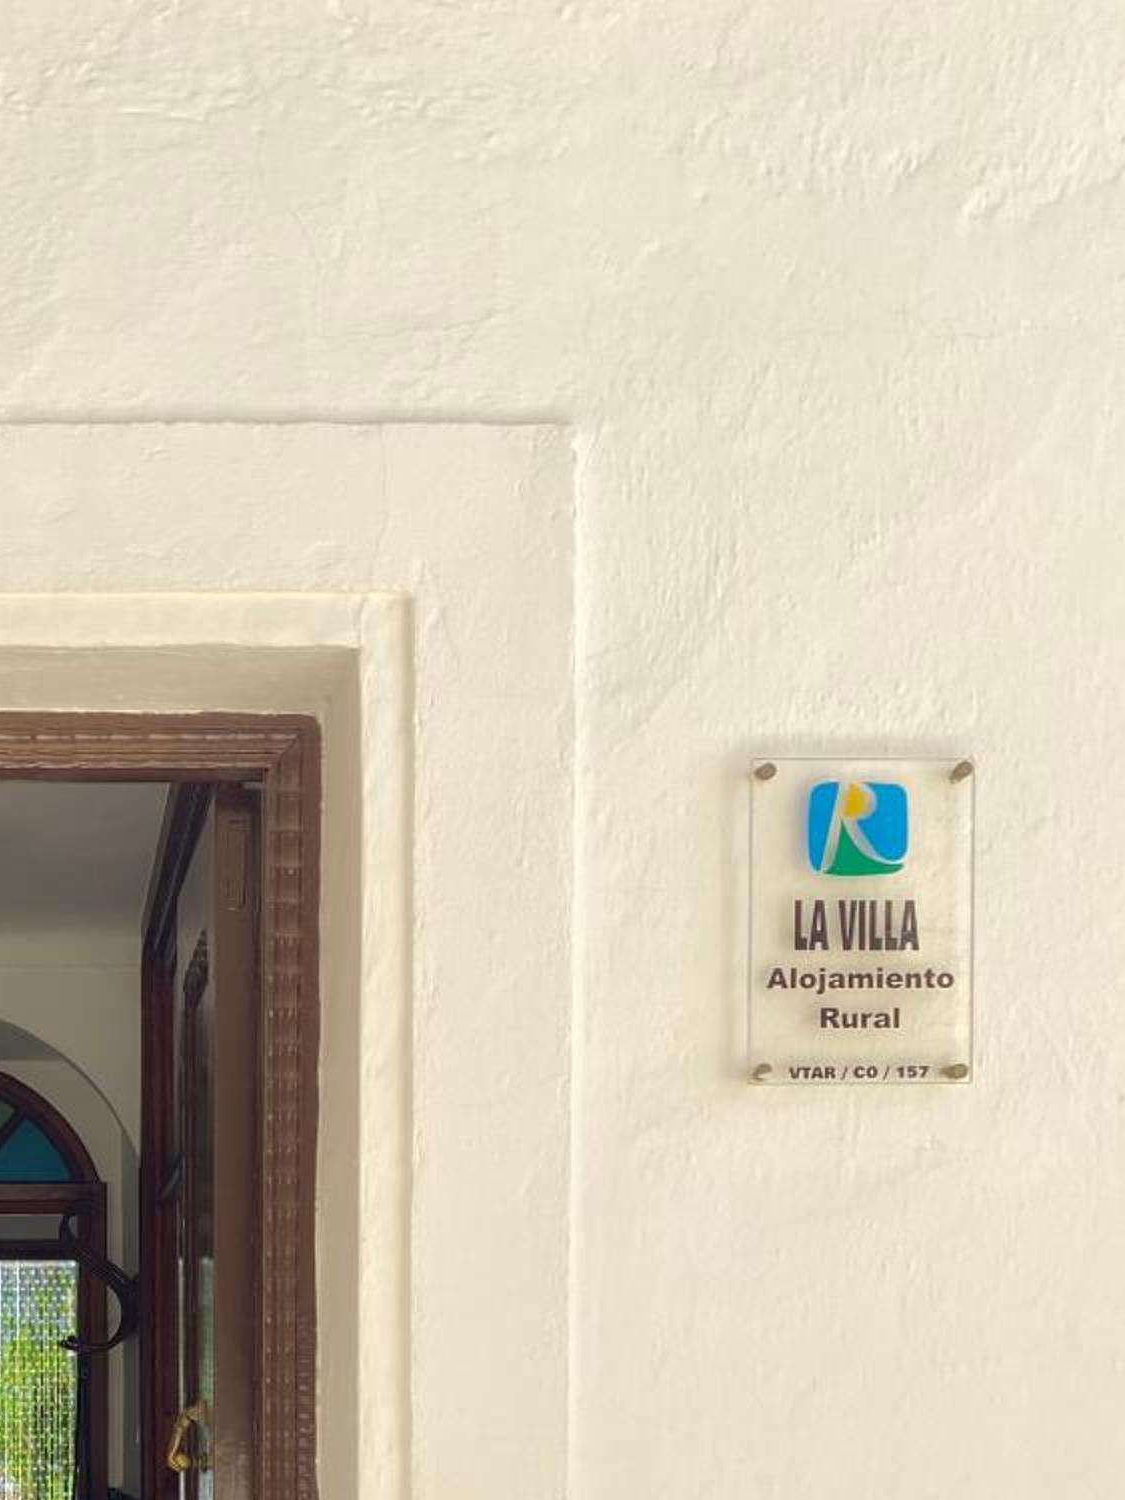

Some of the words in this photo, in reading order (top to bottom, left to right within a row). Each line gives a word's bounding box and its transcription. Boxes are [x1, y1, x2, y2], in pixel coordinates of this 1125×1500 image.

[794, 900, 829, 950] LA
[838, 900, 919, 950] VILLA
[766, 967, 955, 994] Alojamiento
[819, 1007, 900, 1029] Rural
[789, 1066, 836, 1079] VTAR
[897, 1066, 930, 1078] 157
